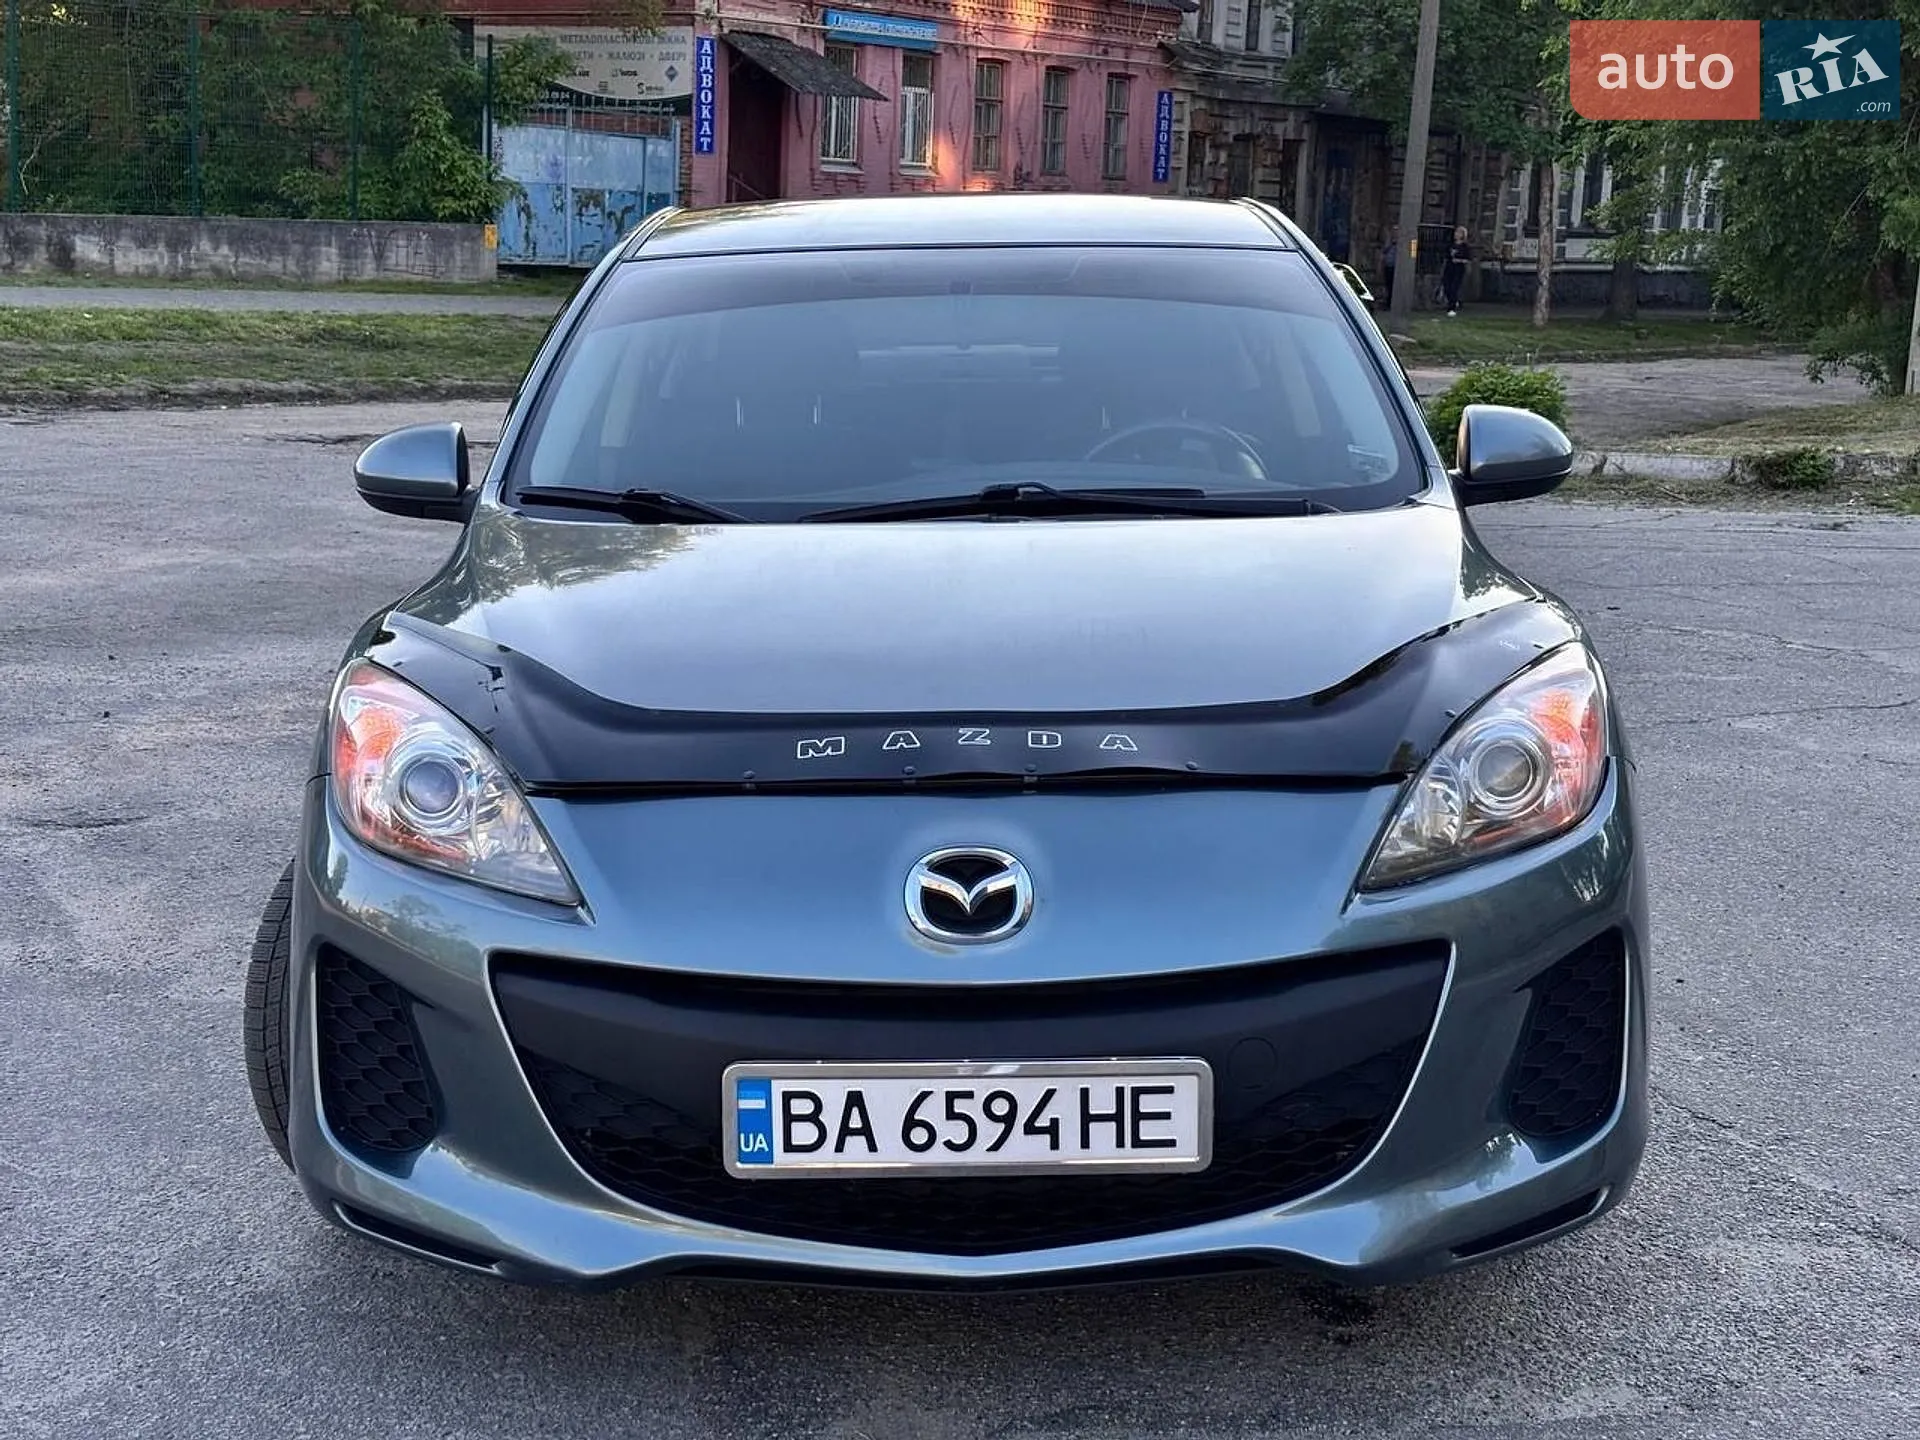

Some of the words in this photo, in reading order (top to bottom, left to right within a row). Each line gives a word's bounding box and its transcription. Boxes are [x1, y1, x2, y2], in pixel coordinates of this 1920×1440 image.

[700, 40, 713, 152] АДВОКАТ
[1157, 93, 1170, 180] АДВОКАТ
[796, 727, 1139, 760] MAZDA
[740, 1132, 769, 1153] UA
[900, 1086, 1060, 1153] 6594
